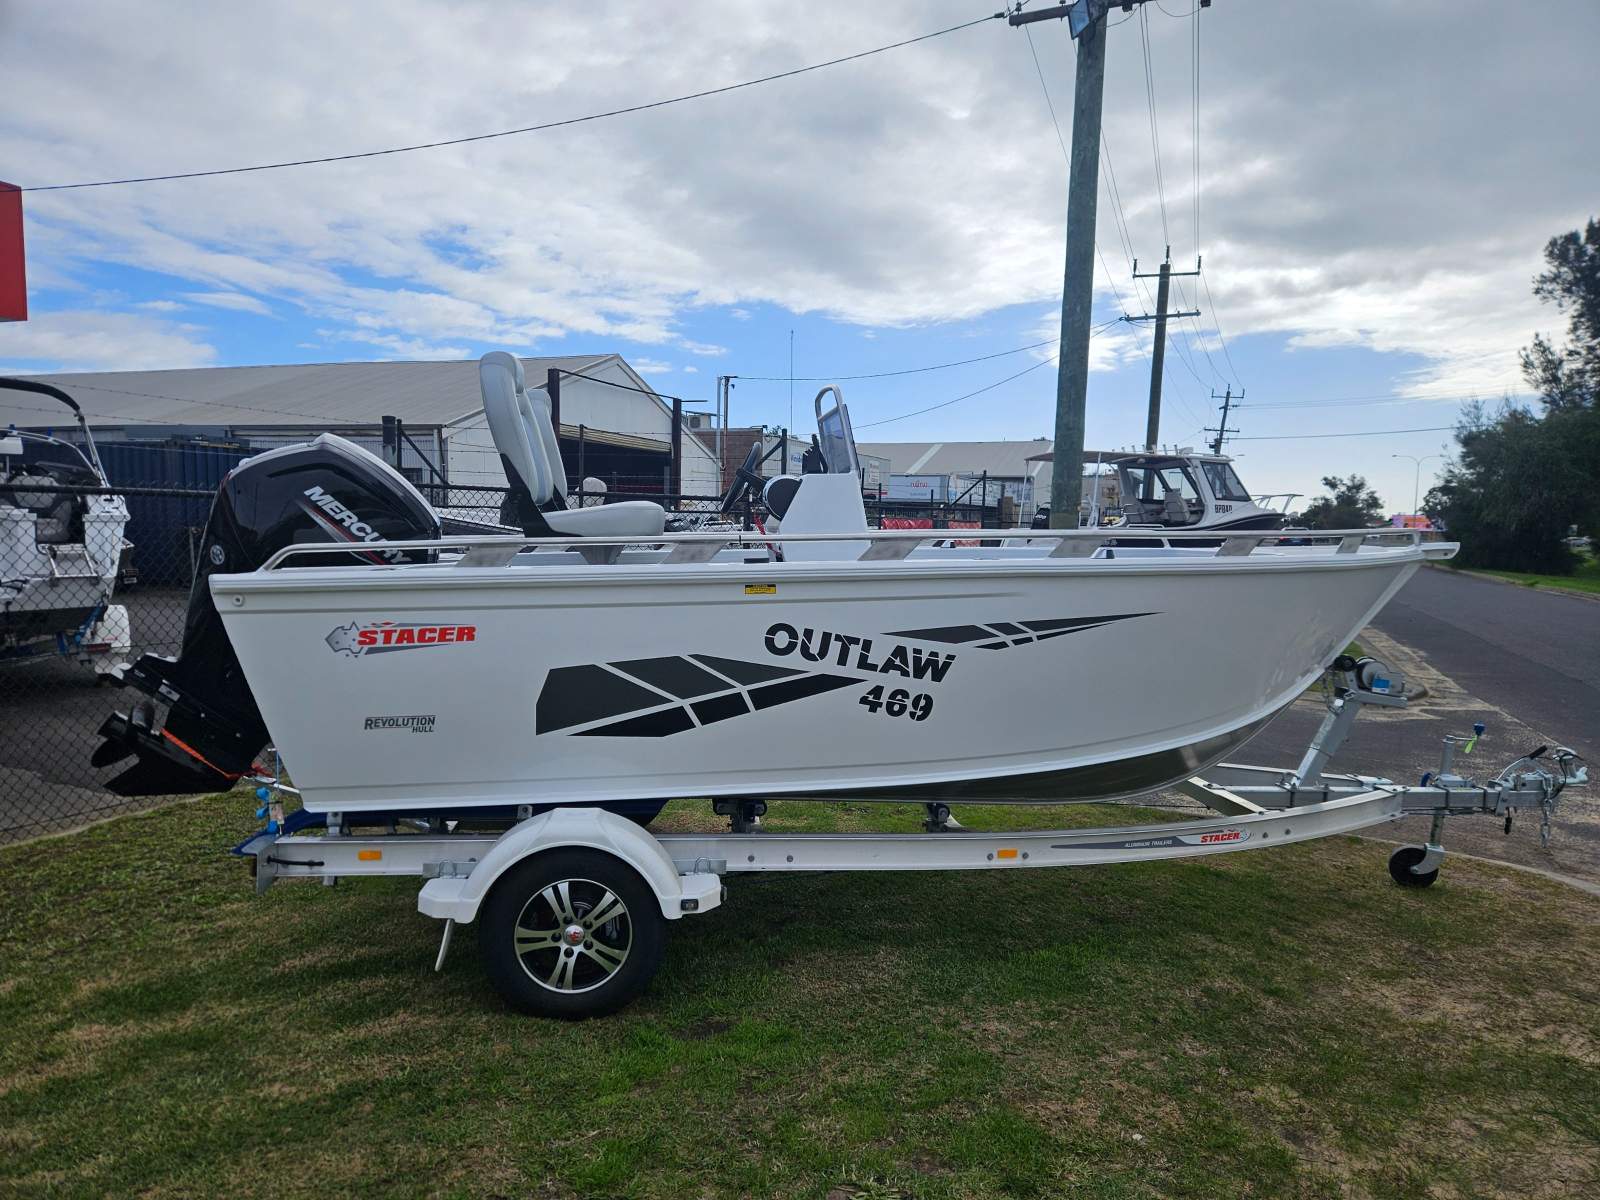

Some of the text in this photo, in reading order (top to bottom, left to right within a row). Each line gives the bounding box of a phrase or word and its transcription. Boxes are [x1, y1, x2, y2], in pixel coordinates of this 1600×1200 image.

[357, 626, 476, 646] STACER
[764, 622, 957, 683] OUTLAW
[858, 685, 934, 722] 469
[364, 715, 436, 730] REVOLUTION
[412, 725, 434, 733] HULL
[1201, 832, 1240, 843] STACER
